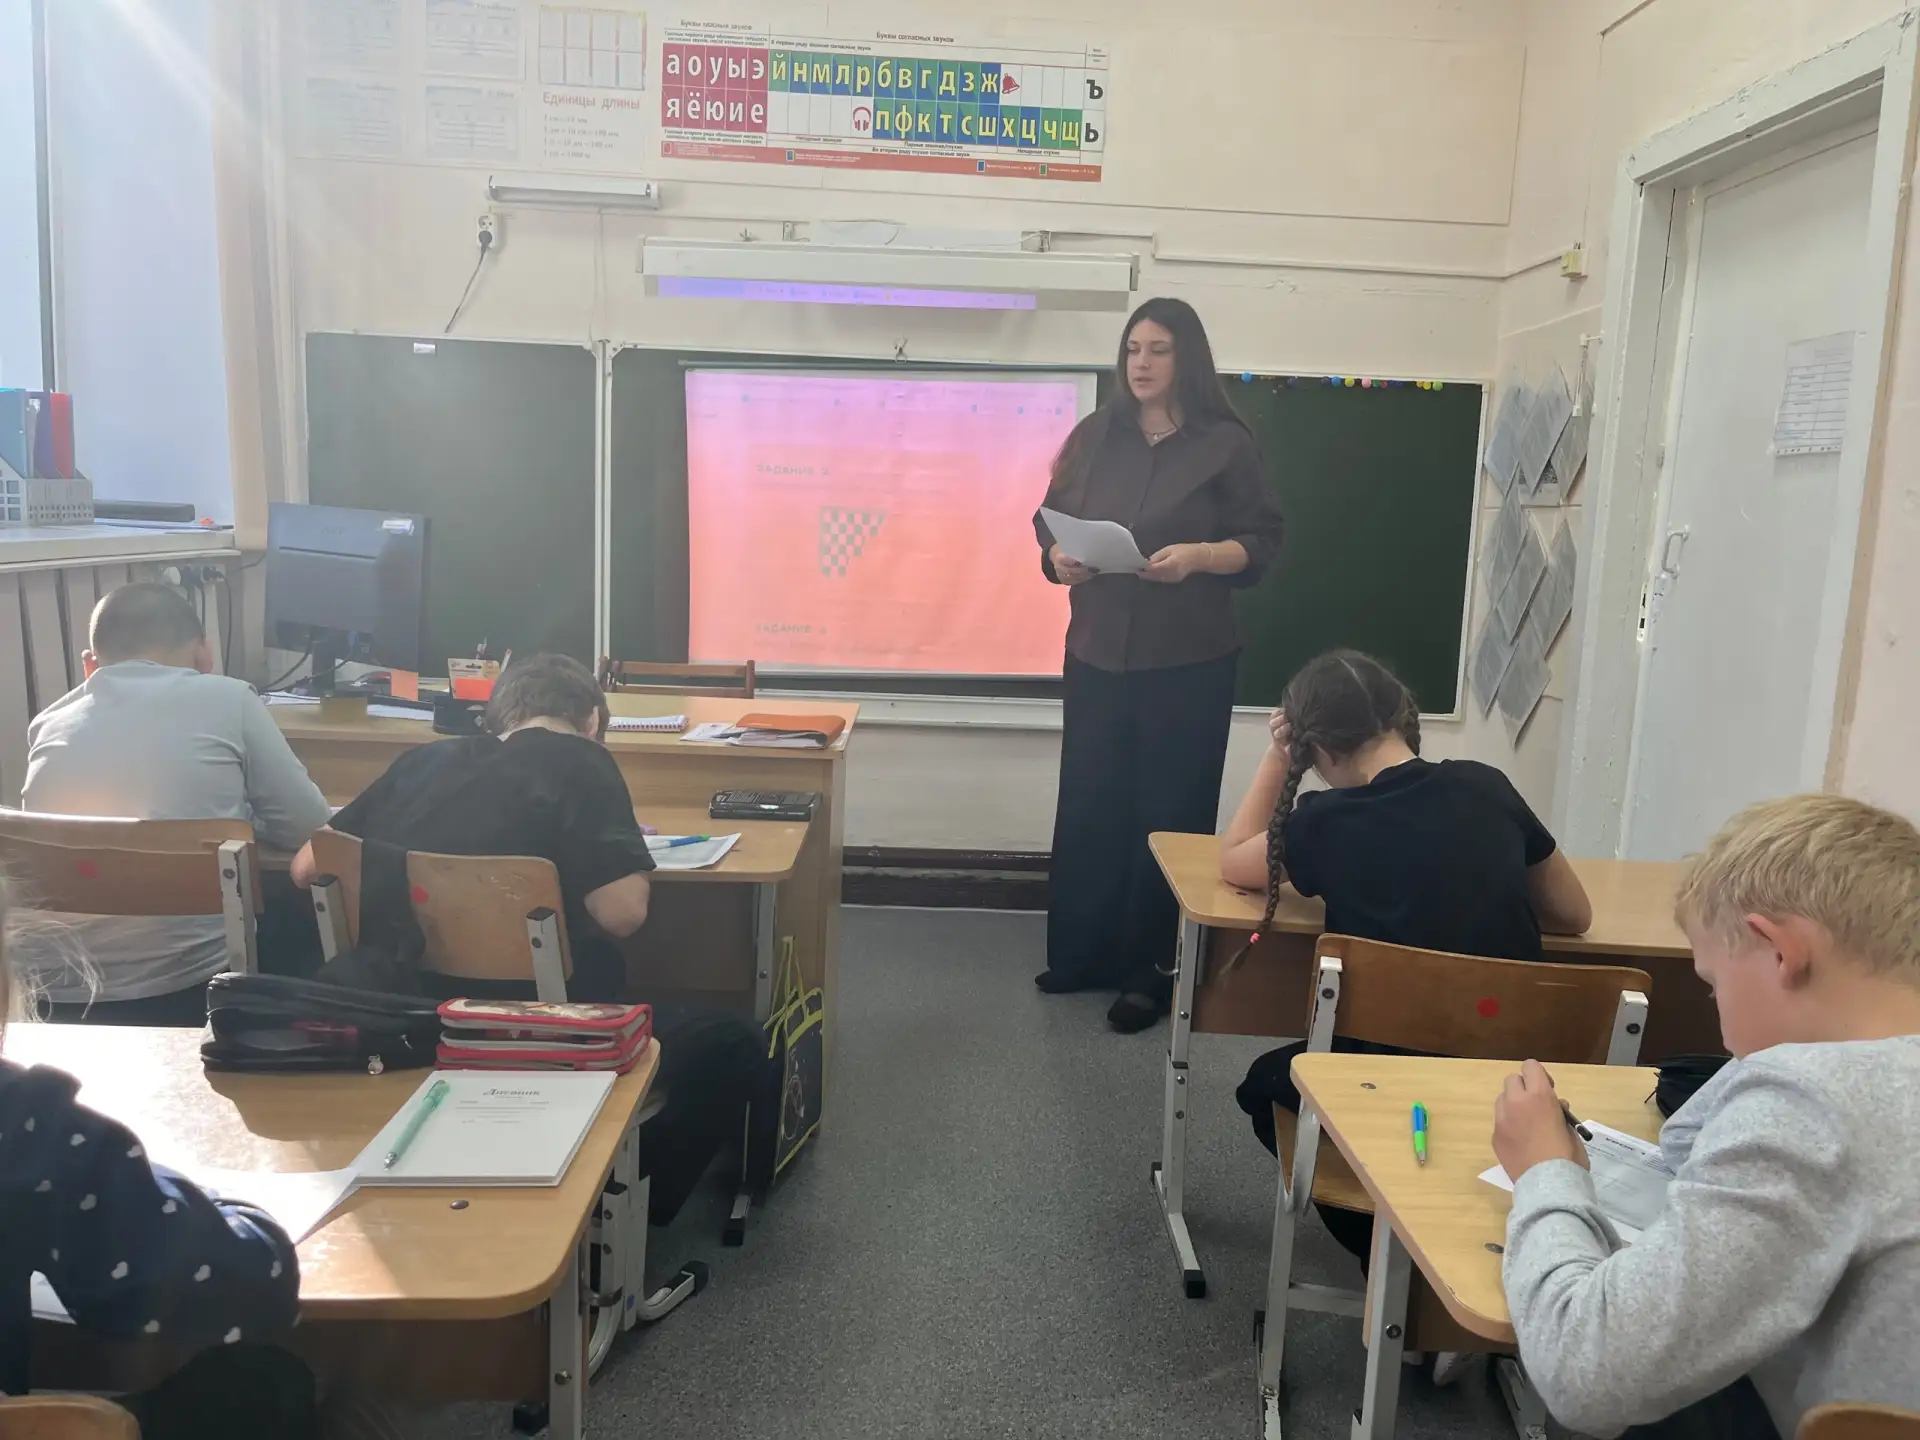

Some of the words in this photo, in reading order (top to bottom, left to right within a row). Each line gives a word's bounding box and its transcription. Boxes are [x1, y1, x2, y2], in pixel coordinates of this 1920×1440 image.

[681, 19, 701, 28] Буквы
[877, 30, 896, 40] Буквы
[898, 33, 930, 42] согласных
[932, 35, 954, 44] звуков
[772, 52, 785, 80] й
[794, 63, 806, 82] н
[812, 64, 829, 83] м
[835, 65, 849, 84] л
[857, 65, 870, 92] р
[898, 67, 912, 88] в
[921, 69, 932, 88] г
[939, 71, 956, 96] д
[962, 72, 975, 92] з
[981, 73, 998, 93] ж
[543, 91, 596, 108] Единицы
[602, 97, 640, 111] длины
[876, 111, 890, 130] п
[895, 104, 913, 139] ф
[918, 113, 931, 132] к
[940, 114, 953, 133] т
[961, 115, 973, 135] с
[978, 116, 996, 136] ш
[1002, 117, 1015, 137] х
[1022, 118, 1036, 144] ц
[1044, 120, 1057, 140] ч
[1062, 121, 1079, 146] щ
